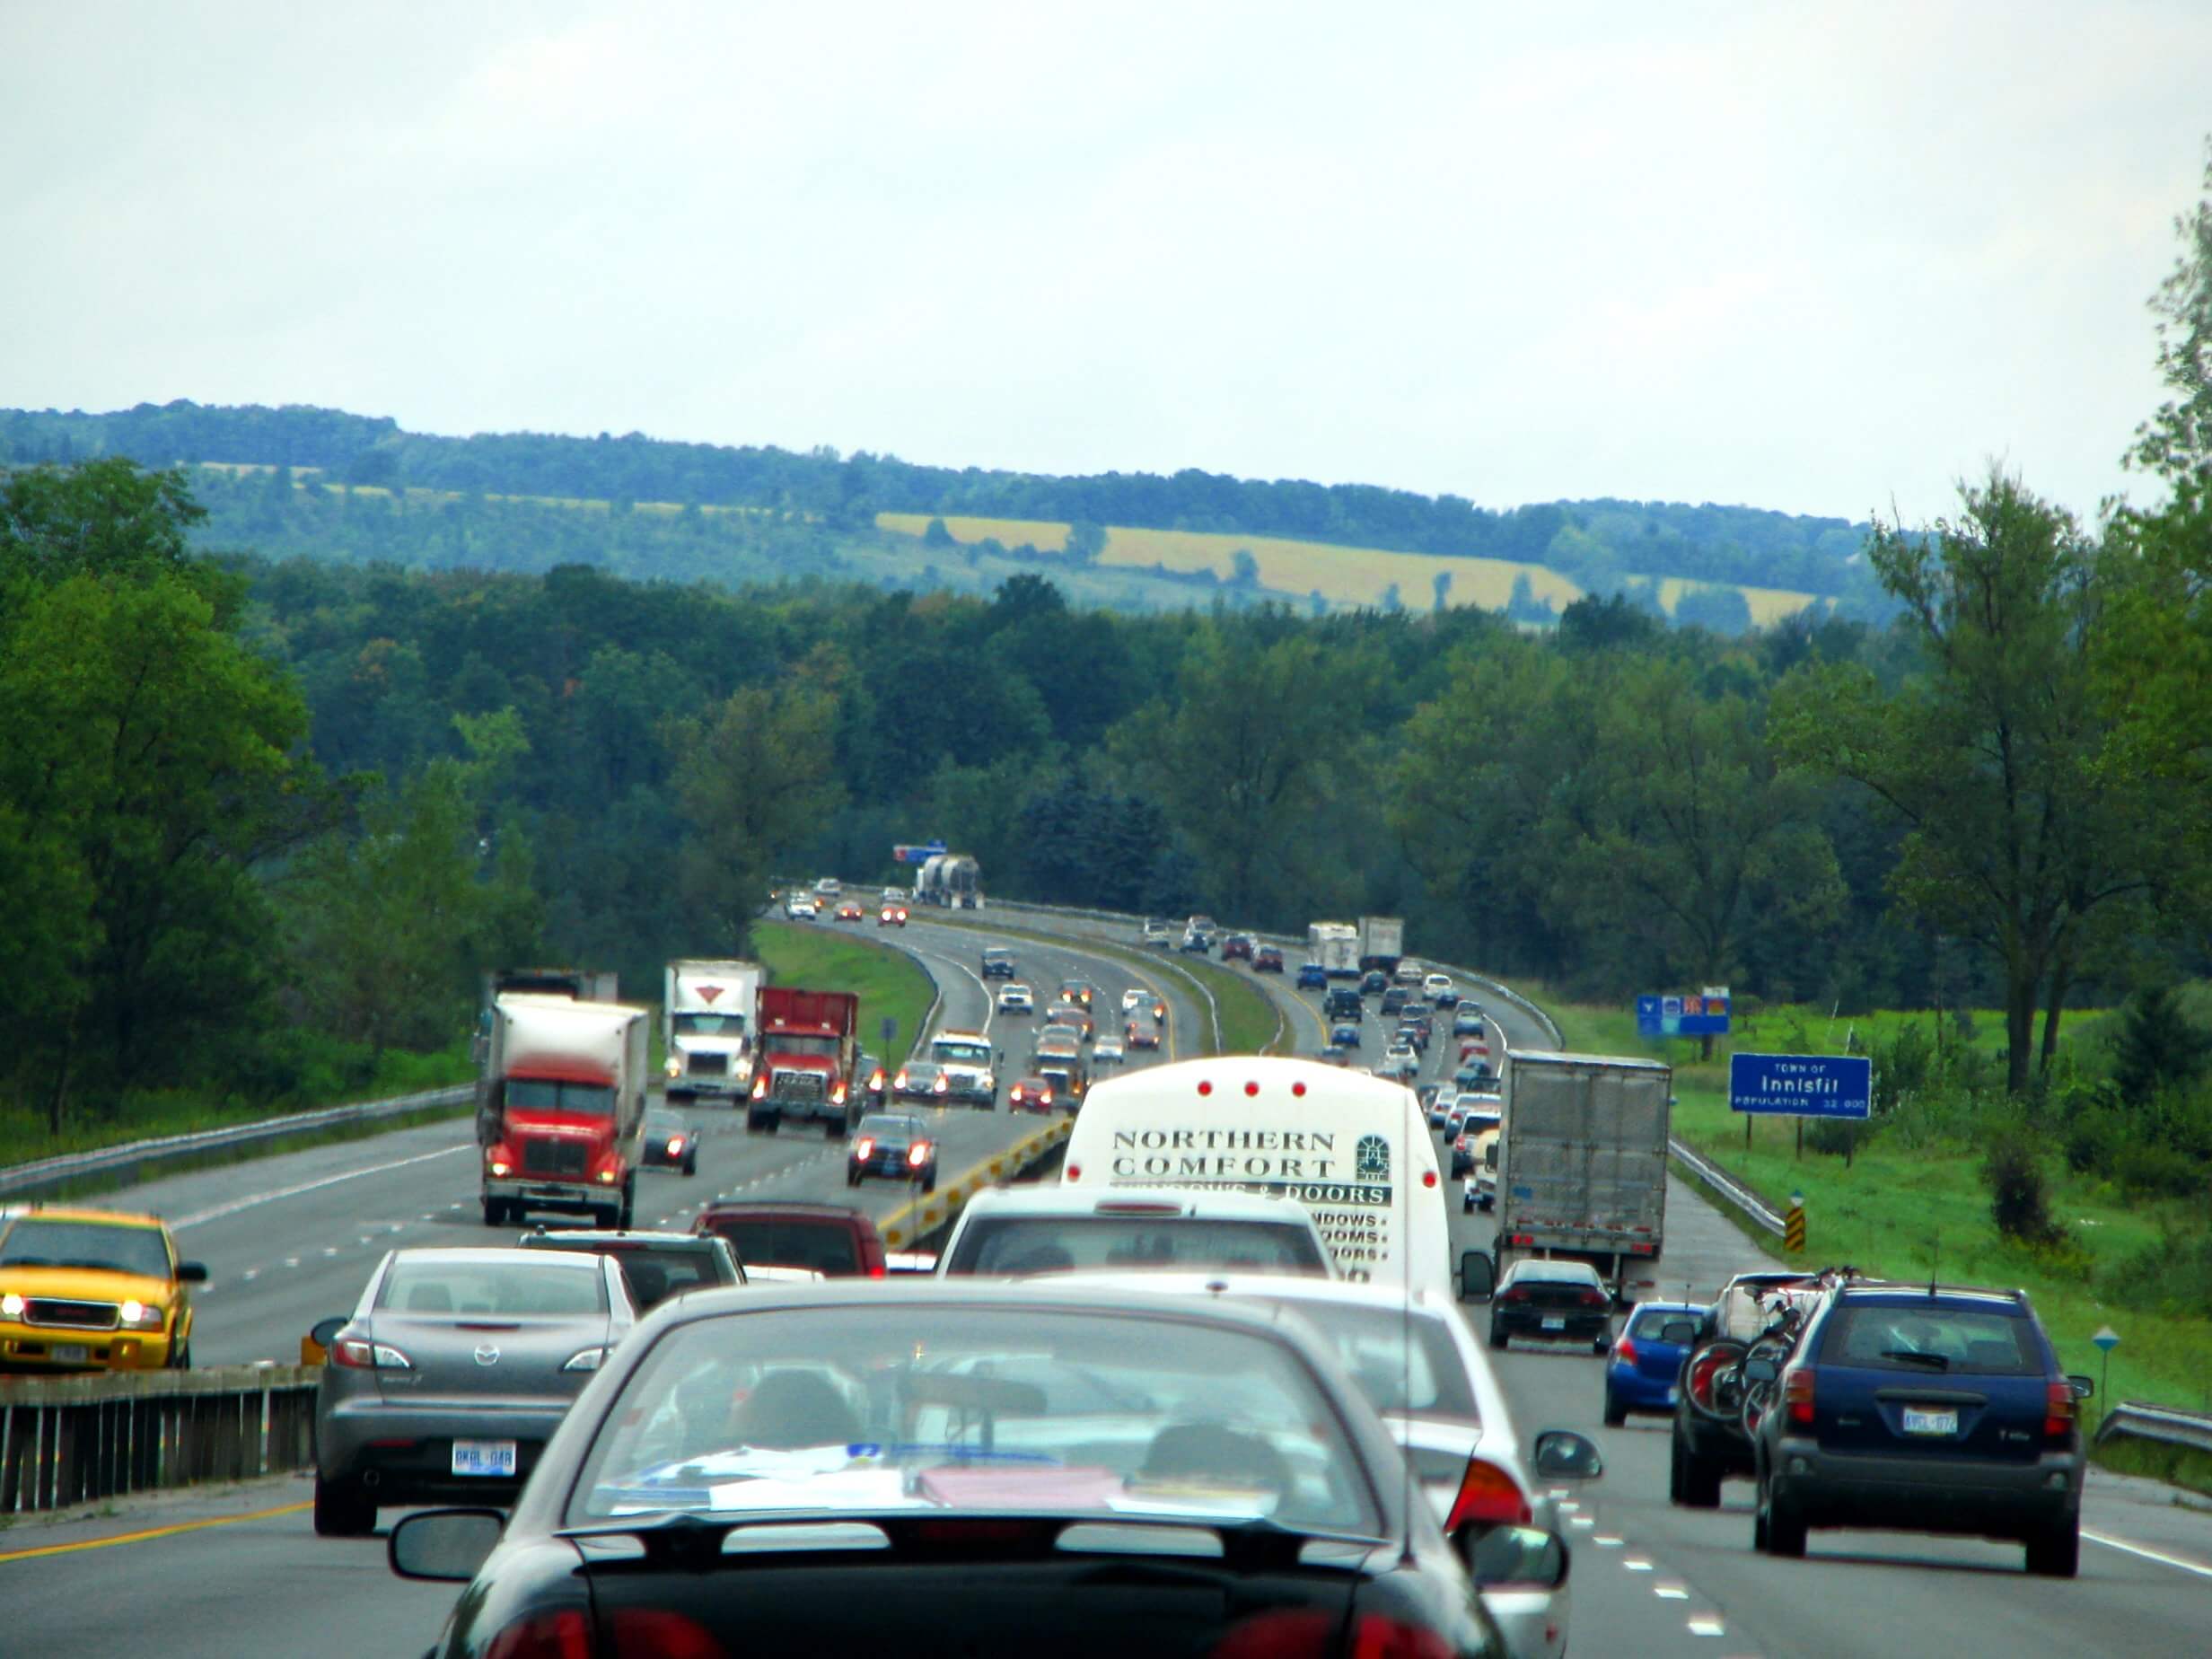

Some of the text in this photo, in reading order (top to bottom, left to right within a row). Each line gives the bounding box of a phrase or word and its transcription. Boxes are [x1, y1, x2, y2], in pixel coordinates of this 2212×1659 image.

[1774, 1063, 1827, 1074] TOWN OF
[1761, 1075, 1839, 1093] Innisfil
[1734, 1094, 1809, 1107] POPULATION
[1113, 1129, 1336, 1152] NORTHERN
[1112, 1156, 1336, 1178] COMFORT
[1285, 1184, 1385, 1205] DOORS
